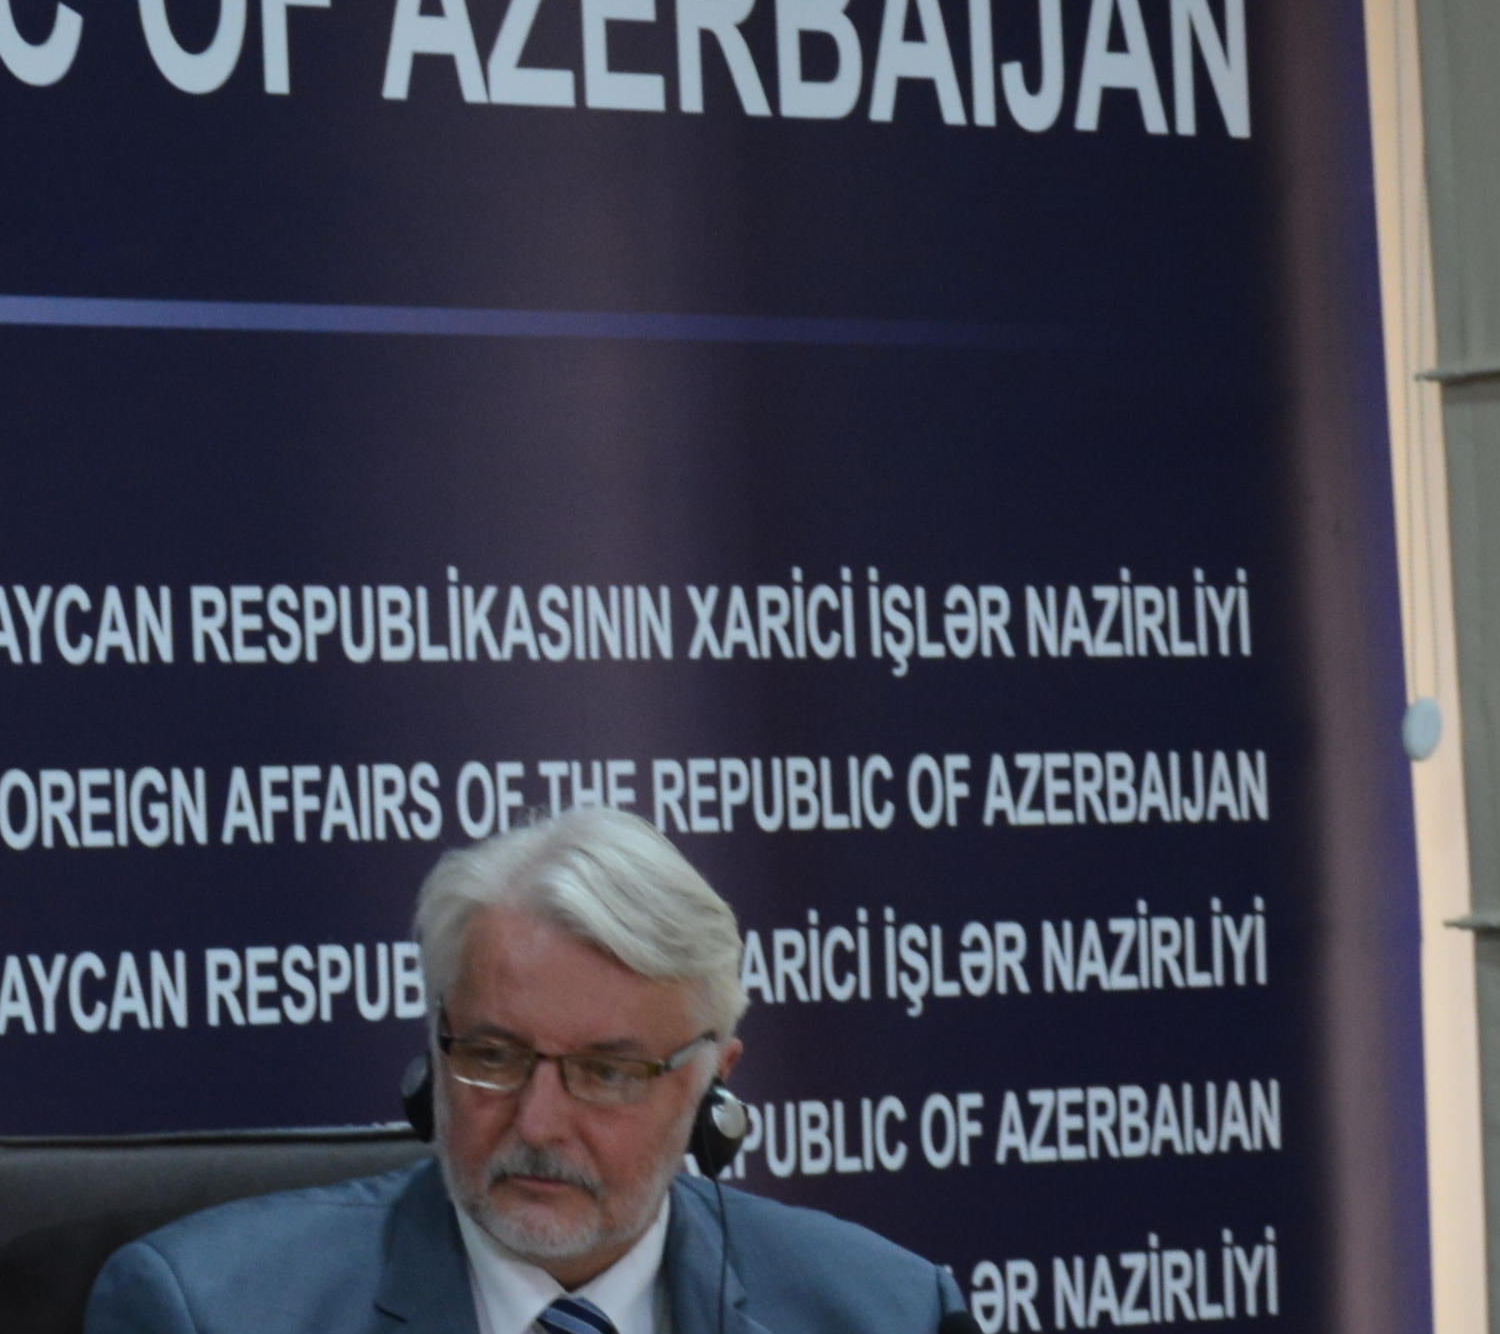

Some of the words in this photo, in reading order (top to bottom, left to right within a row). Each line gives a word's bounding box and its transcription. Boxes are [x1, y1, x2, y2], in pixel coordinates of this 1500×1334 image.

[190, 565, 673, 665] RESPUBLİKASININ
[686, 566, 856, 660] XARİCİ
[867, 566, 1016, 678] İŞLƏR
[1025, 567, 1252, 658] NAZİRLİYİ
[221, 761, 443, 845] AFFAIRS
[456, 761, 525, 839] OF
[538, 759, 637, 817] THE
[652, 754, 896, 835] REPUBLIC
[907, 753, 971, 829] OF
[982, 749, 1269, 827] AZERBAIJAN
[884, 906, 1031, 1018] İŞLƏR
[1041, 895, 1267, 993] NAZİRLİYİ
[920, 1092, 984, 1169] OF
[995, 1078, 1282, 1165] AZERBAIJAN
[1052, 1225, 1279, 1330] NAZİRLİYİ
